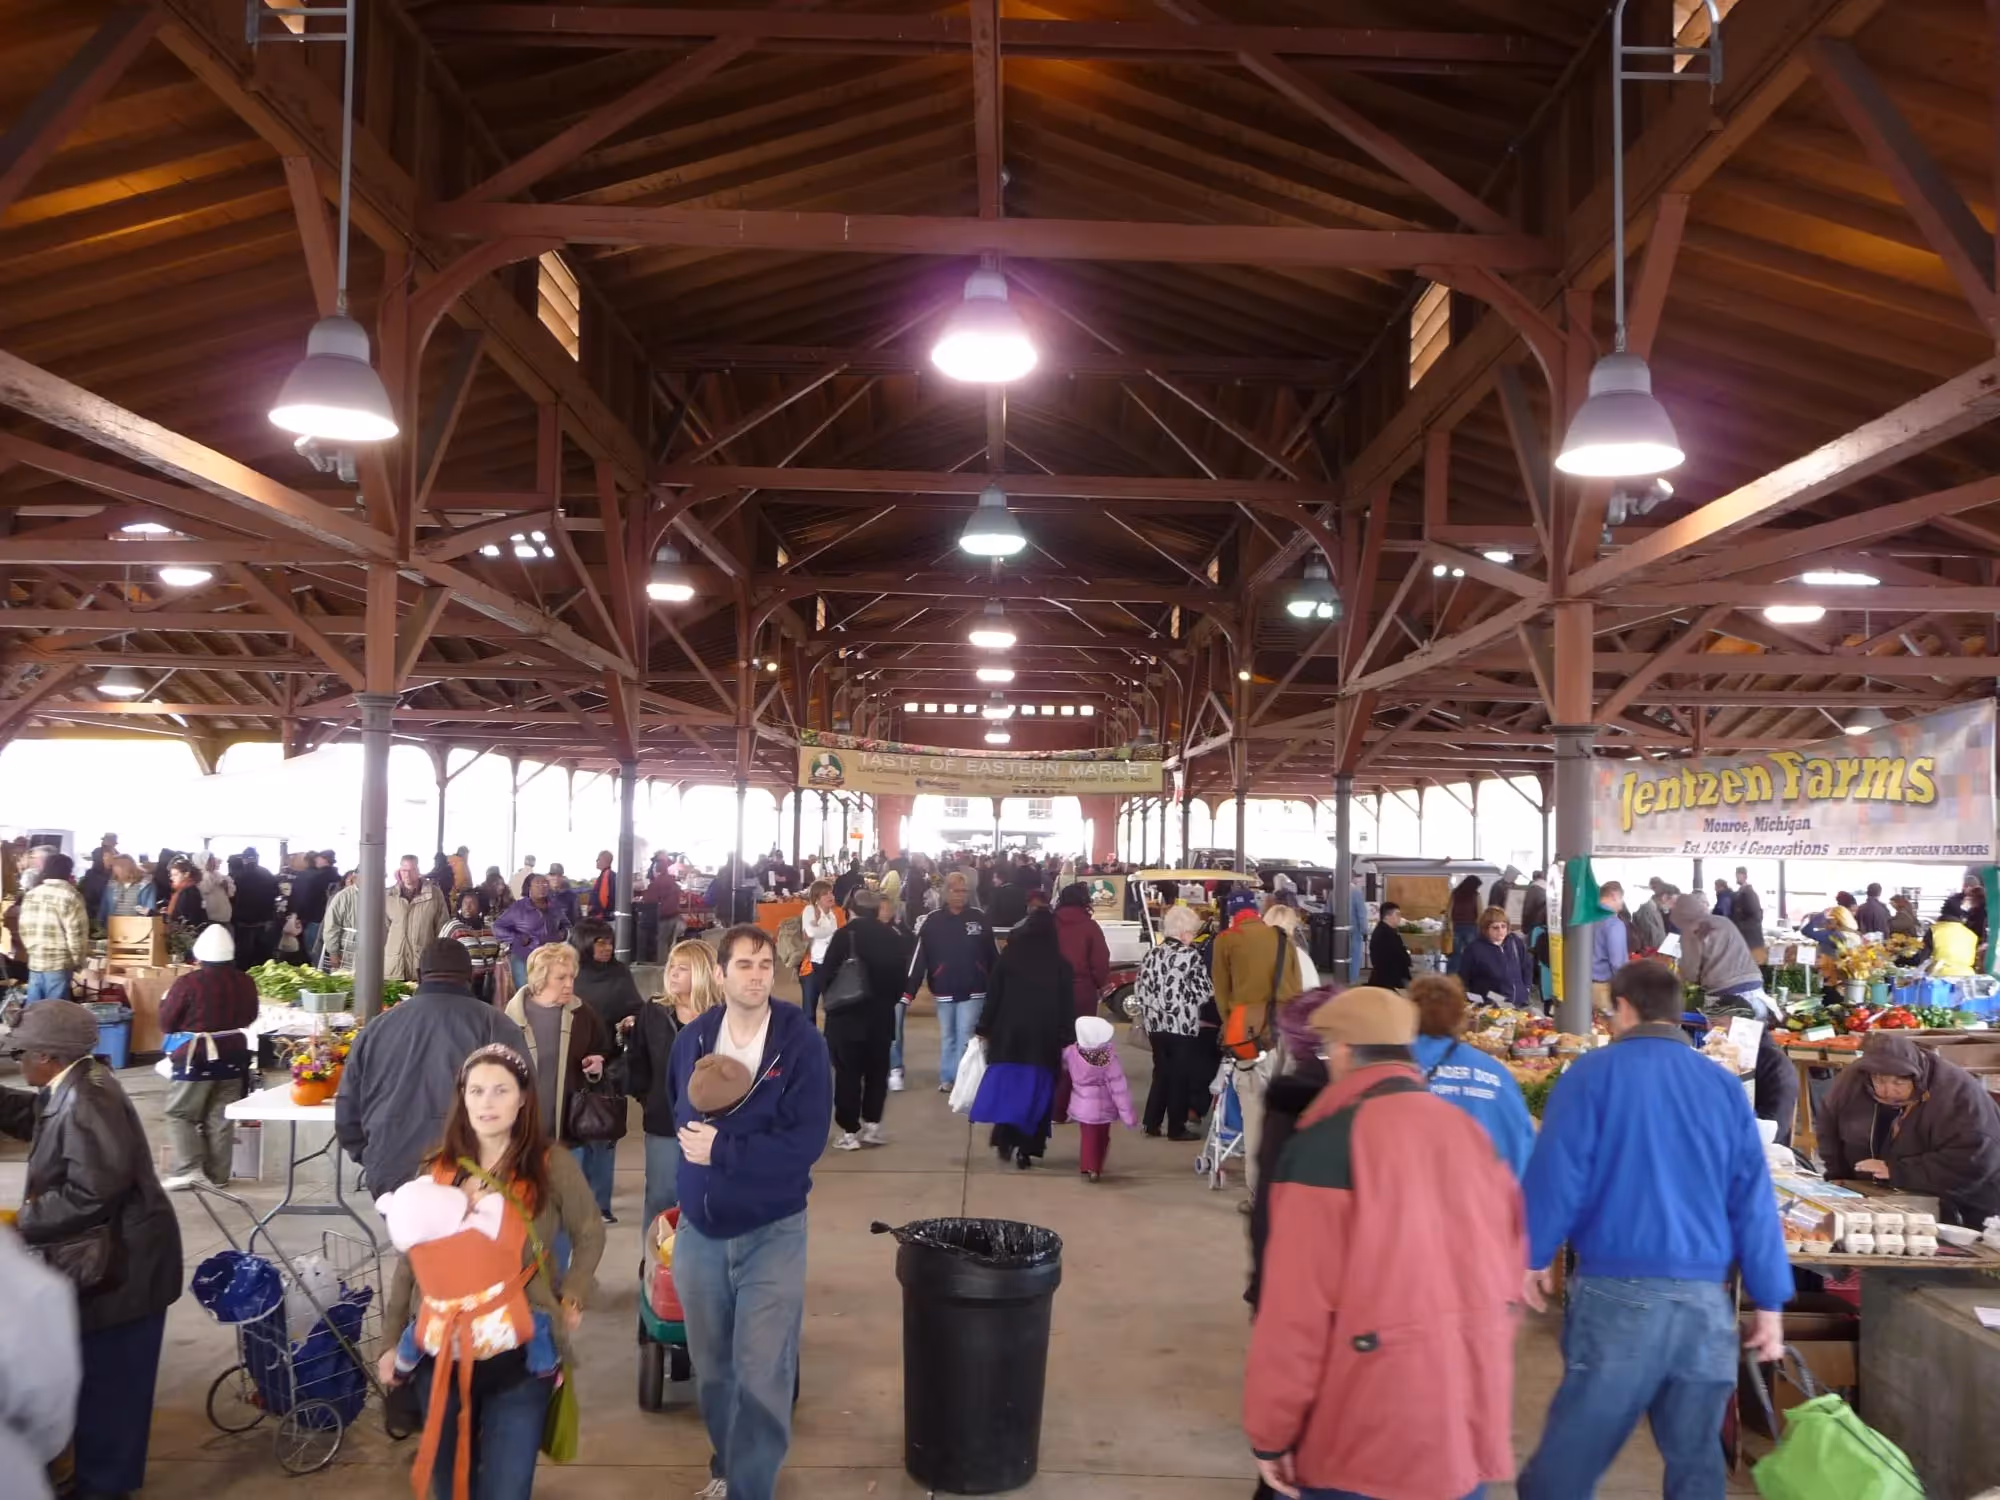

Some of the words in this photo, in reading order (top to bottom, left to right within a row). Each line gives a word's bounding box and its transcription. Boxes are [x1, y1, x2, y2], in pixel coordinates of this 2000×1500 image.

[858, 752, 920, 769] TASTE
[929, 757, 955, 771] OF
[967, 759, 1059, 775] EASTERN
[1068, 763, 1153, 776] MARKET
[1622, 763, 1774, 832] Jentzen
[1767, 751, 1936, 804] Farms
[1703, 817, 1751, 836] Monroe,
[1752, 815, 1812, 836] Michigan
[1702, 840, 1732, 855] 1936
[1739, 840, 1749, 855] 4
[1748, 839, 1830, 856] Generations
[1894, 845, 1941, 856] MICHIGAN
[1941, 844, 1989, 856] FARMERS
